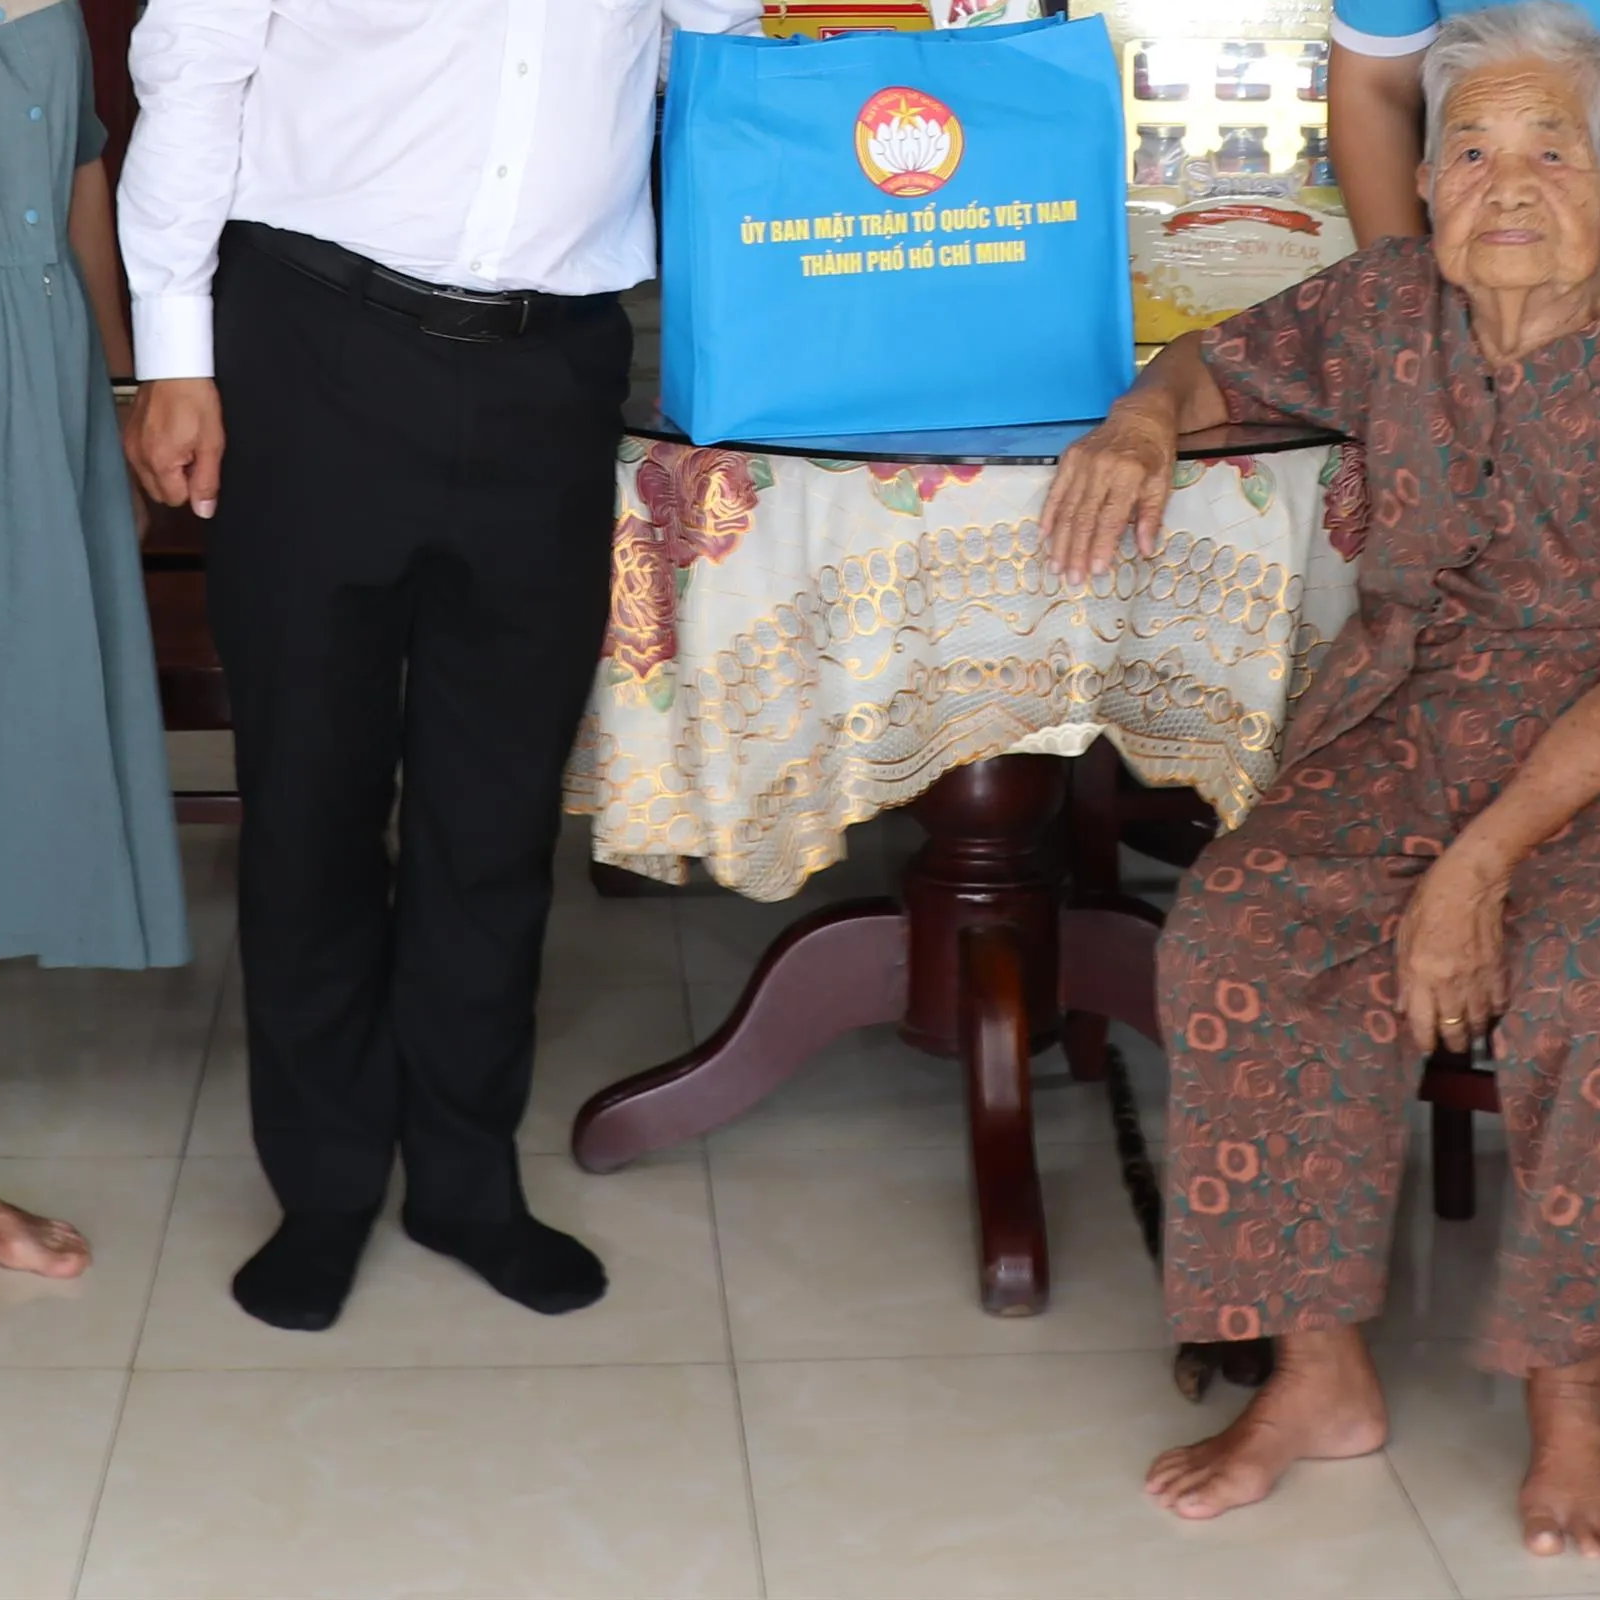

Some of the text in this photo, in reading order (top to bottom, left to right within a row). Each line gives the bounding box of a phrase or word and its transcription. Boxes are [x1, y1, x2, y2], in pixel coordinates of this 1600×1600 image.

[740, 215, 766, 245] ỦY
[770, 218, 810, 243] BAN
[813, 212, 855, 244] MẶT
[858, 209, 908, 240] TRẬN
[940, 200, 991, 232] QUỐC
[994, 200, 1033, 231] VIỆT
[1036, 199, 1077, 224] NAM
[800, 249, 862, 277] THÀNH
[866, 241, 904, 273] PHỐ
[938, 240, 971, 267] CHÍ
[975, 240, 1026, 264] MINH
[1277, 241, 1321, 261] YEAR
